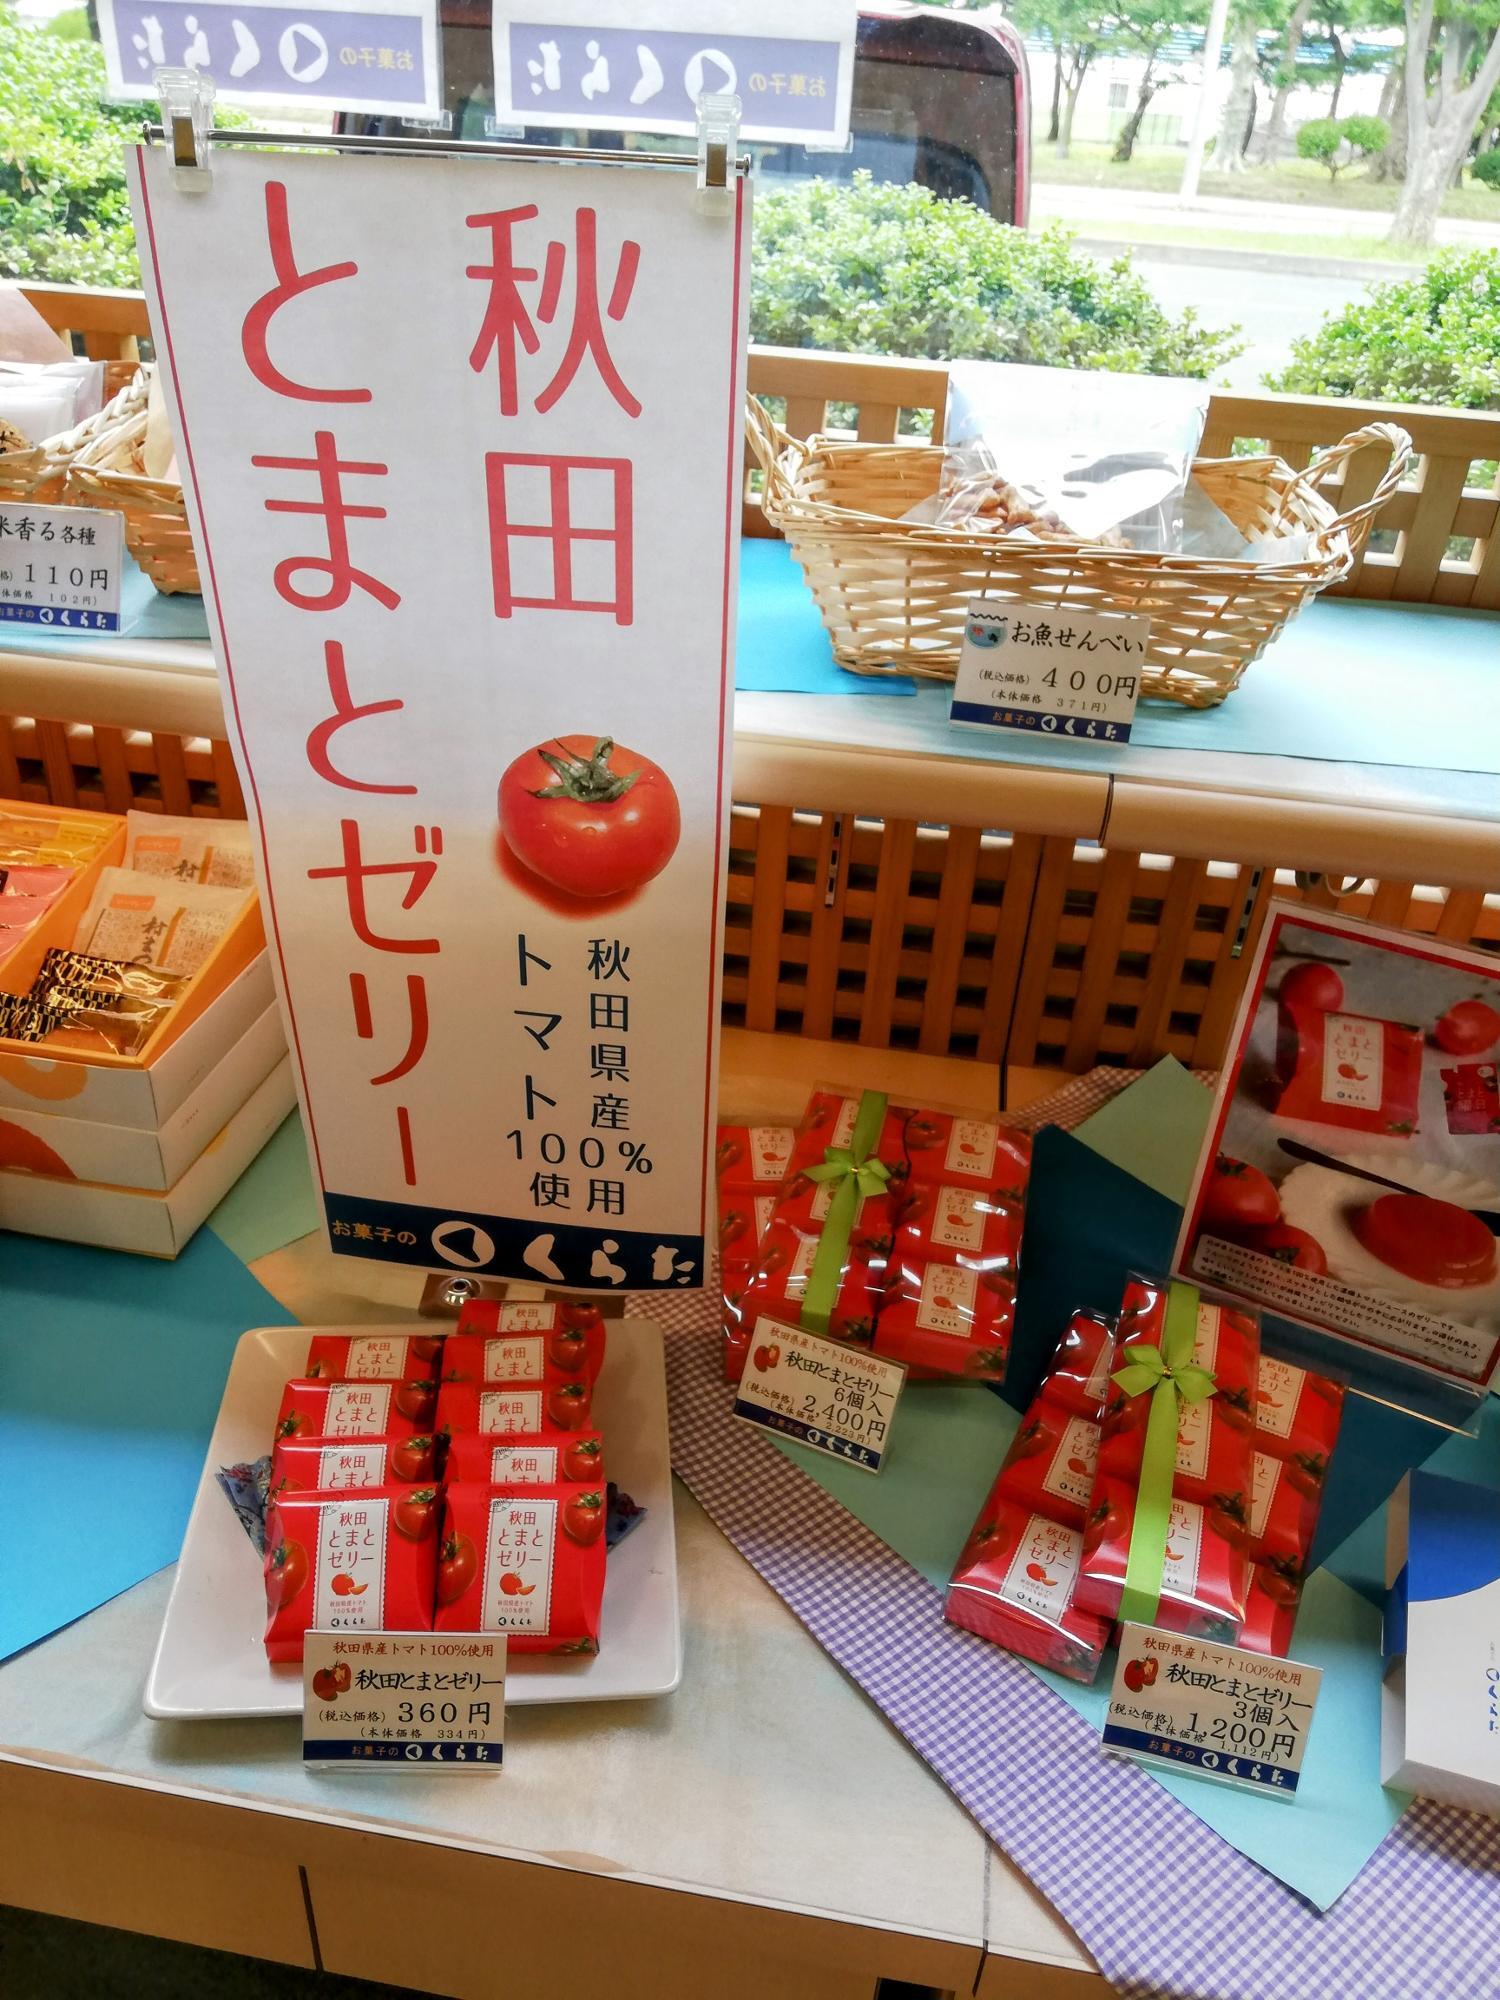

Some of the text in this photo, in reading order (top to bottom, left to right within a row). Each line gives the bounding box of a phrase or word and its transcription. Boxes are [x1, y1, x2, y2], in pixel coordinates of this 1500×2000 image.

[466, 204, 643, 627] 秋田
[1011, 621, 1144, 653] お魚せんべい
[241, 181, 443, 1186] とまとゼリー
[1041, 667, 1137, 700] 400円
[513, 933, 563, 1121] トマト
[587, 938, 631, 1131] 秋田県産
[506, 1129, 653, 1174] 100%
[529, 1171, 625, 1216] 使用
[331, 1219, 417, 1247] お菓子の
[784, 1350, 895, 1399] 秋田とまとゼリー
[335, 1407, 377, 1422] とまと
[834, 1387, 884, 1418] 6個入
[802, 1395, 886, 1442] 2,400円
[340, 1511, 367, 1526] 秋田
[509, 1510, 537, 1526] 秋田
[329, 1528, 375, 1548] とまと
[498, 1528, 543, 1547] とまと
[1032, 1533, 1075, 1560] とまと
[328, 1551, 374, 1568] ゼリー
[497, 1551, 542, 1568] ゼリー
[333, 1641, 495, 1657] 秋田県産トマト100%使用
[1143, 1637, 1302, 1687] 秋田県産トマト100%使用
[354, 1669, 503, 1693] 秋田とまとゼリー
[1165, 1662, 1313, 1710] 秋田とまとゼリー
[397, 1702, 491, 1726] 360円
[1233, 1701, 1300, 1732] 3個入
[1187, 1712, 1296, 1759] 1,200円
